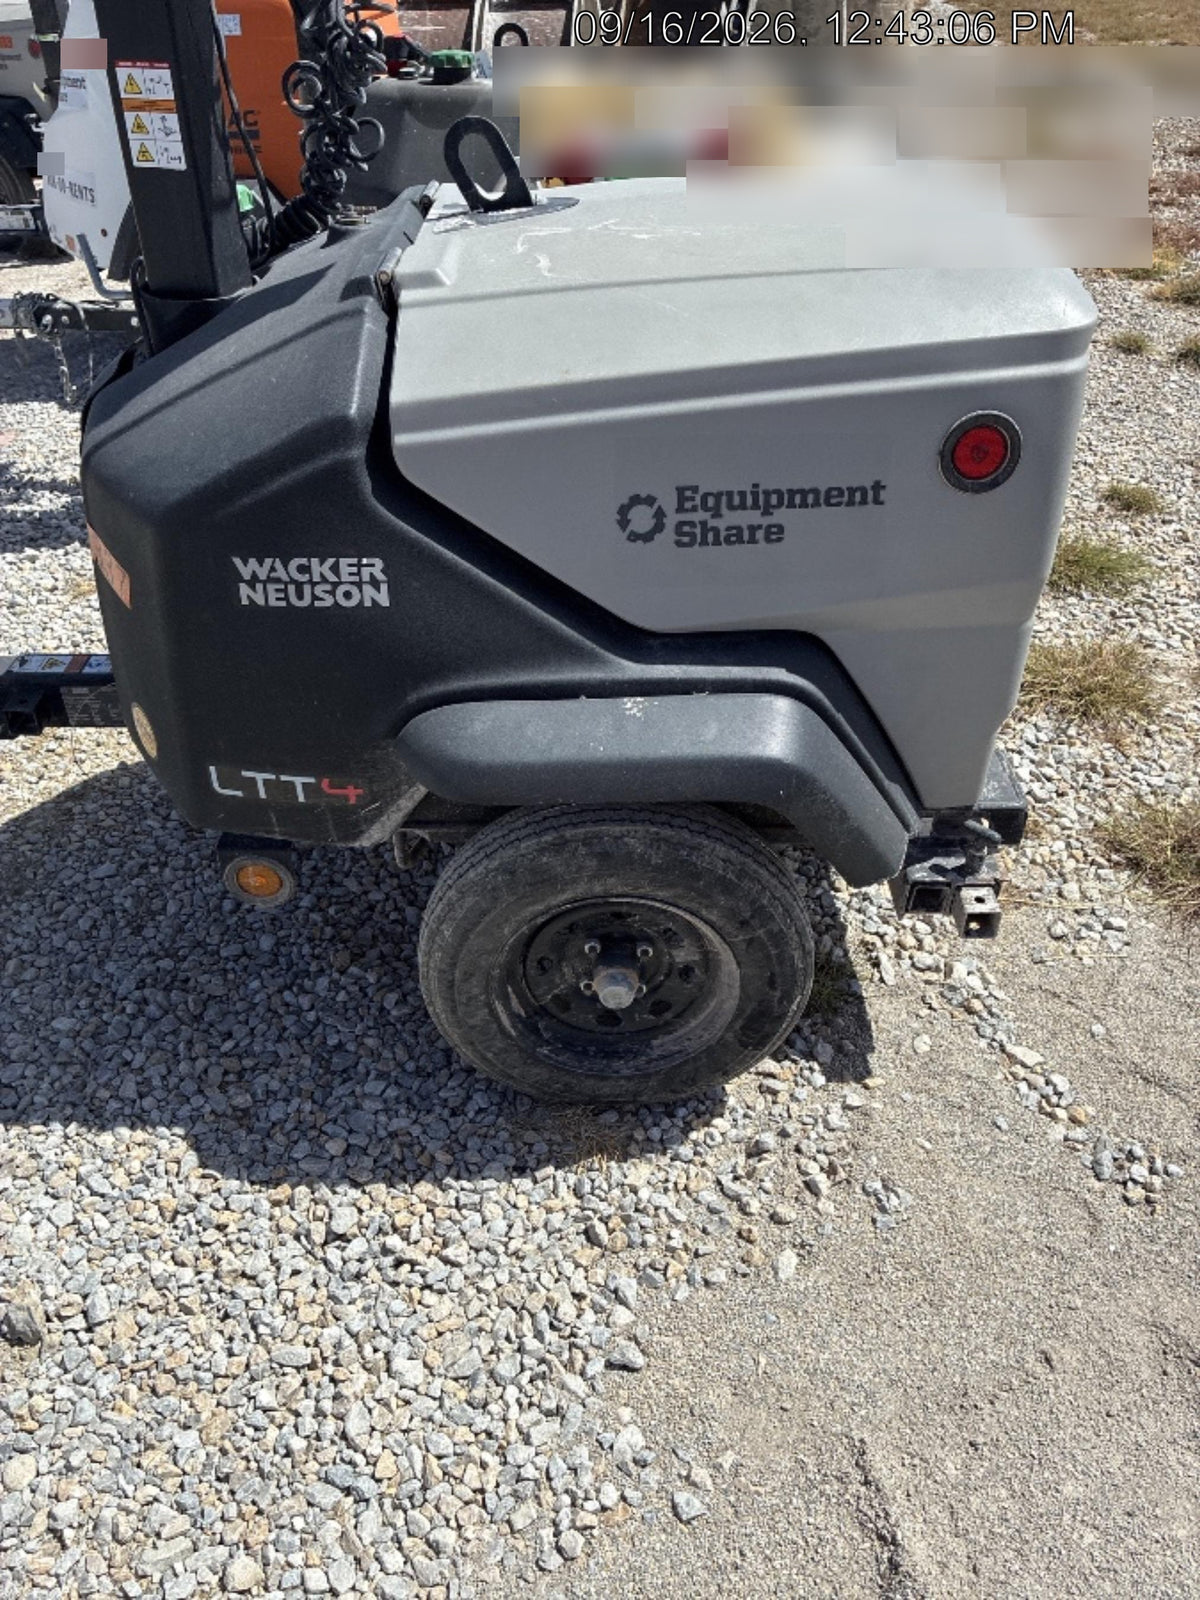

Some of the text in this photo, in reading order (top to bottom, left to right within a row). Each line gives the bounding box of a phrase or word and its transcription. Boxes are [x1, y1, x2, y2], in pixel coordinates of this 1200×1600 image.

[674, 479, 887, 519] Equipment
[673, 519, 785, 548] Share
[231, 556, 388, 582] WACKER
[238, 582, 390, 607] NEUSON
[208, 765, 364, 804] LTT4
